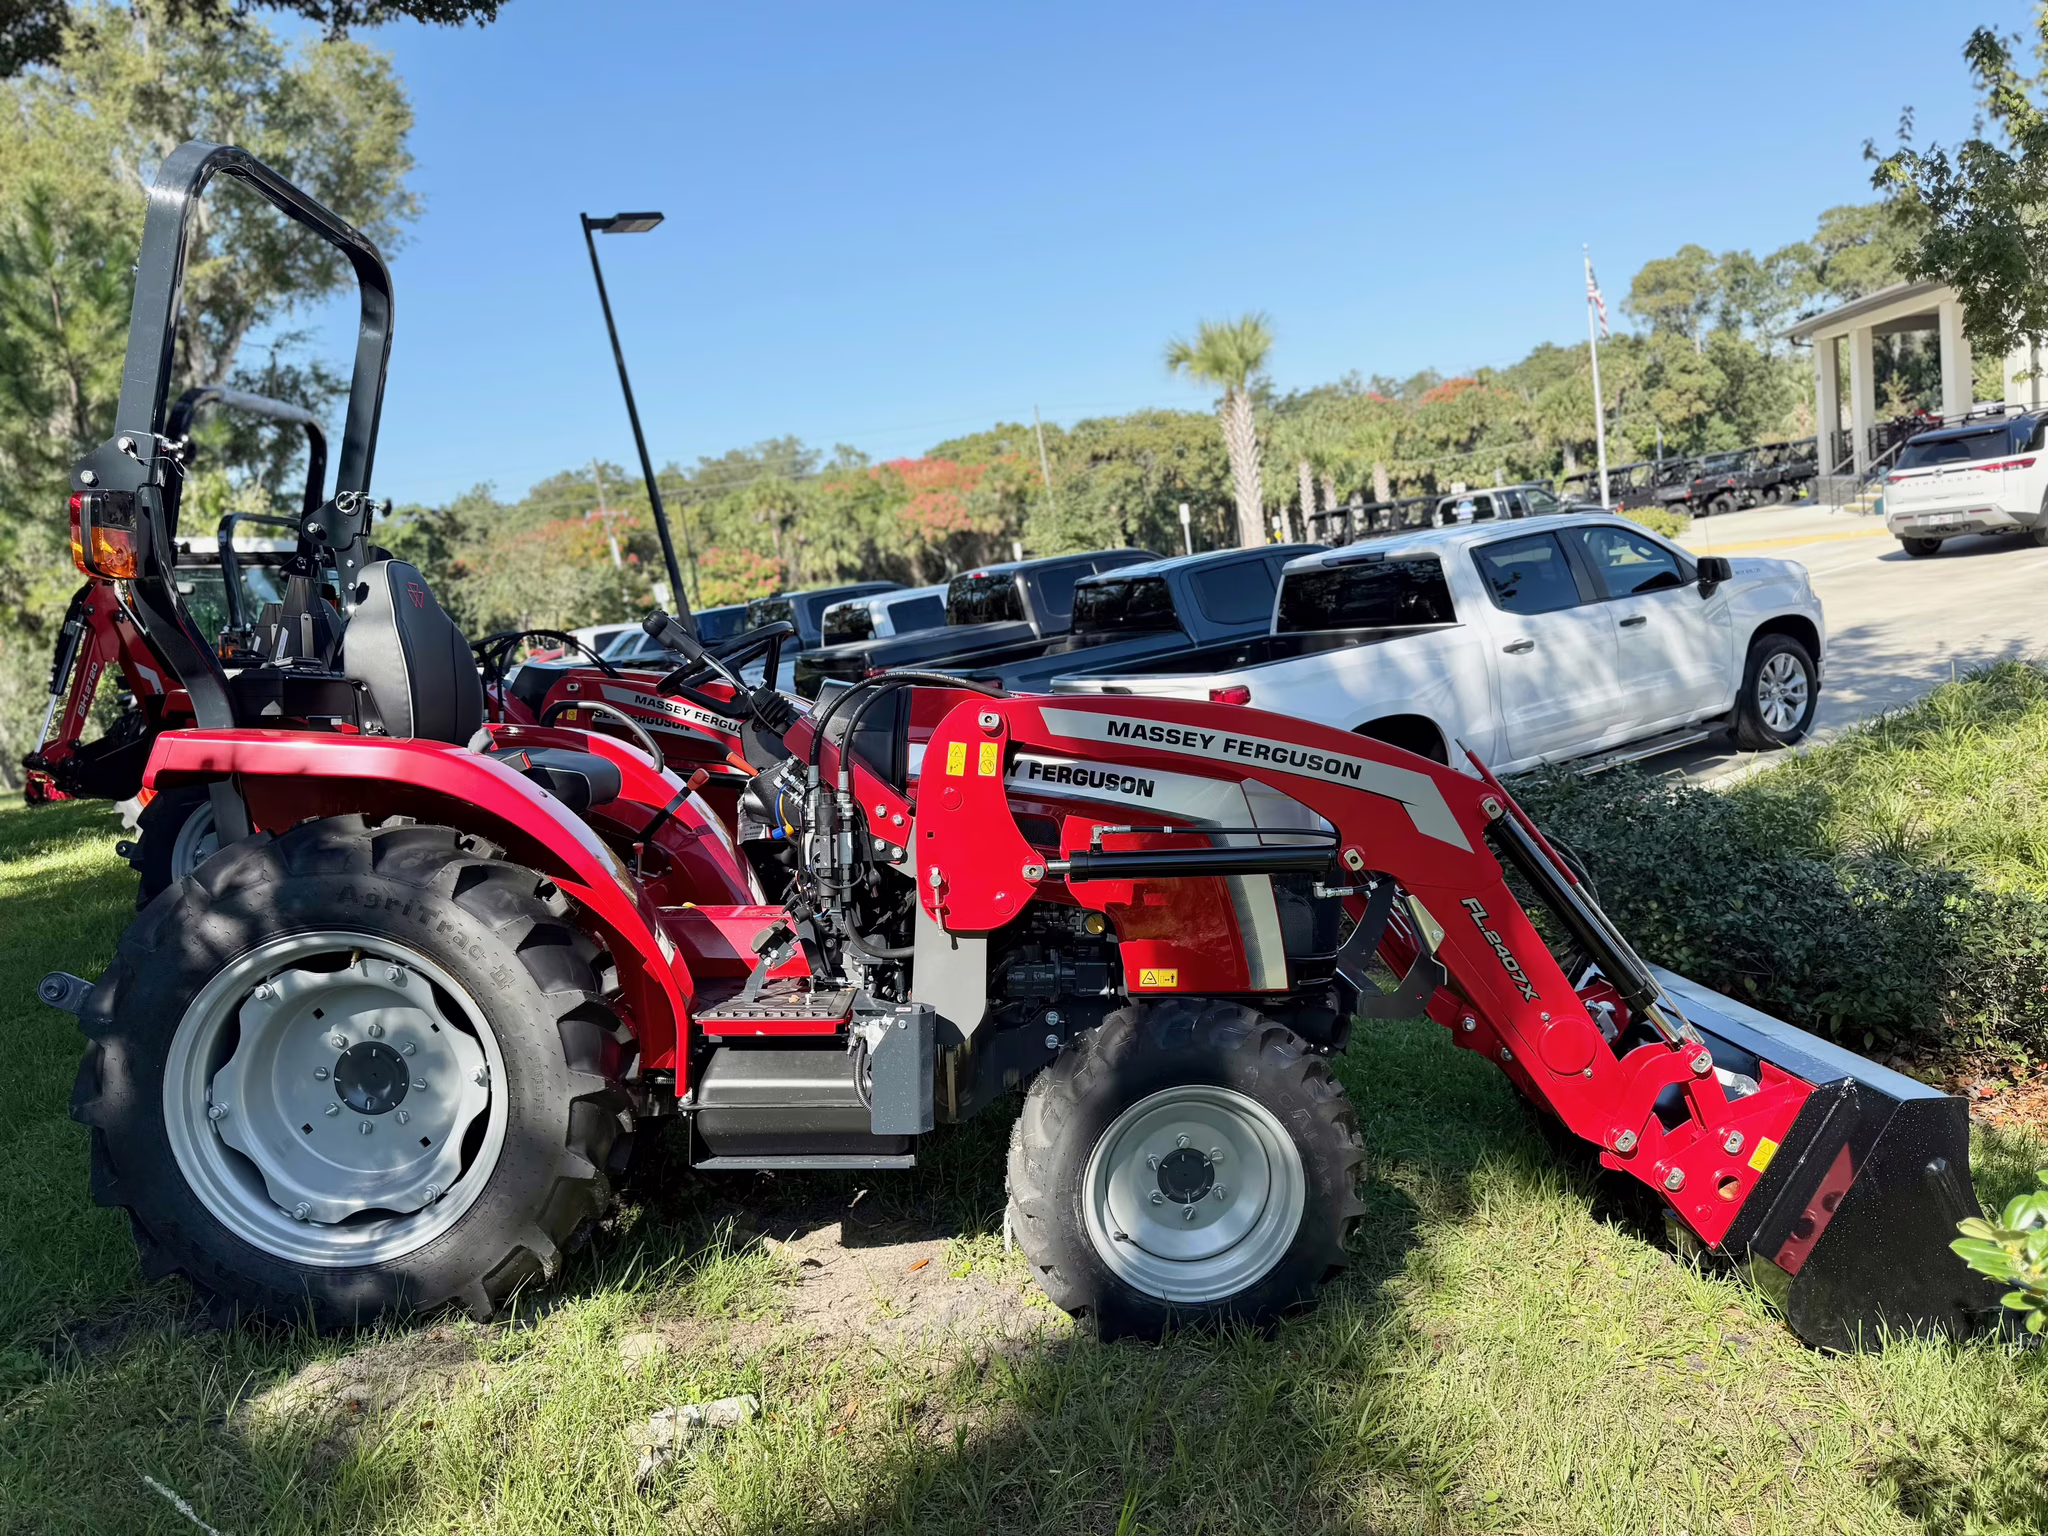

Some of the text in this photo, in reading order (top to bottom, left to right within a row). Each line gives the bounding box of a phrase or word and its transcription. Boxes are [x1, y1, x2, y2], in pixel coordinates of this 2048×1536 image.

[77, 661, 98, 718] BH.2720
[635, 694, 691, 716] MASSEY
[694, 711, 742, 734] FERGUS
[1107, 720, 1362, 779] MASSEY FERGUSON
[1028, 763, 1155, 797] FERGUSON
[337, 883, 485, 961] AgriTrac
[1460, 896, 1542, 1004] FL.2407X
